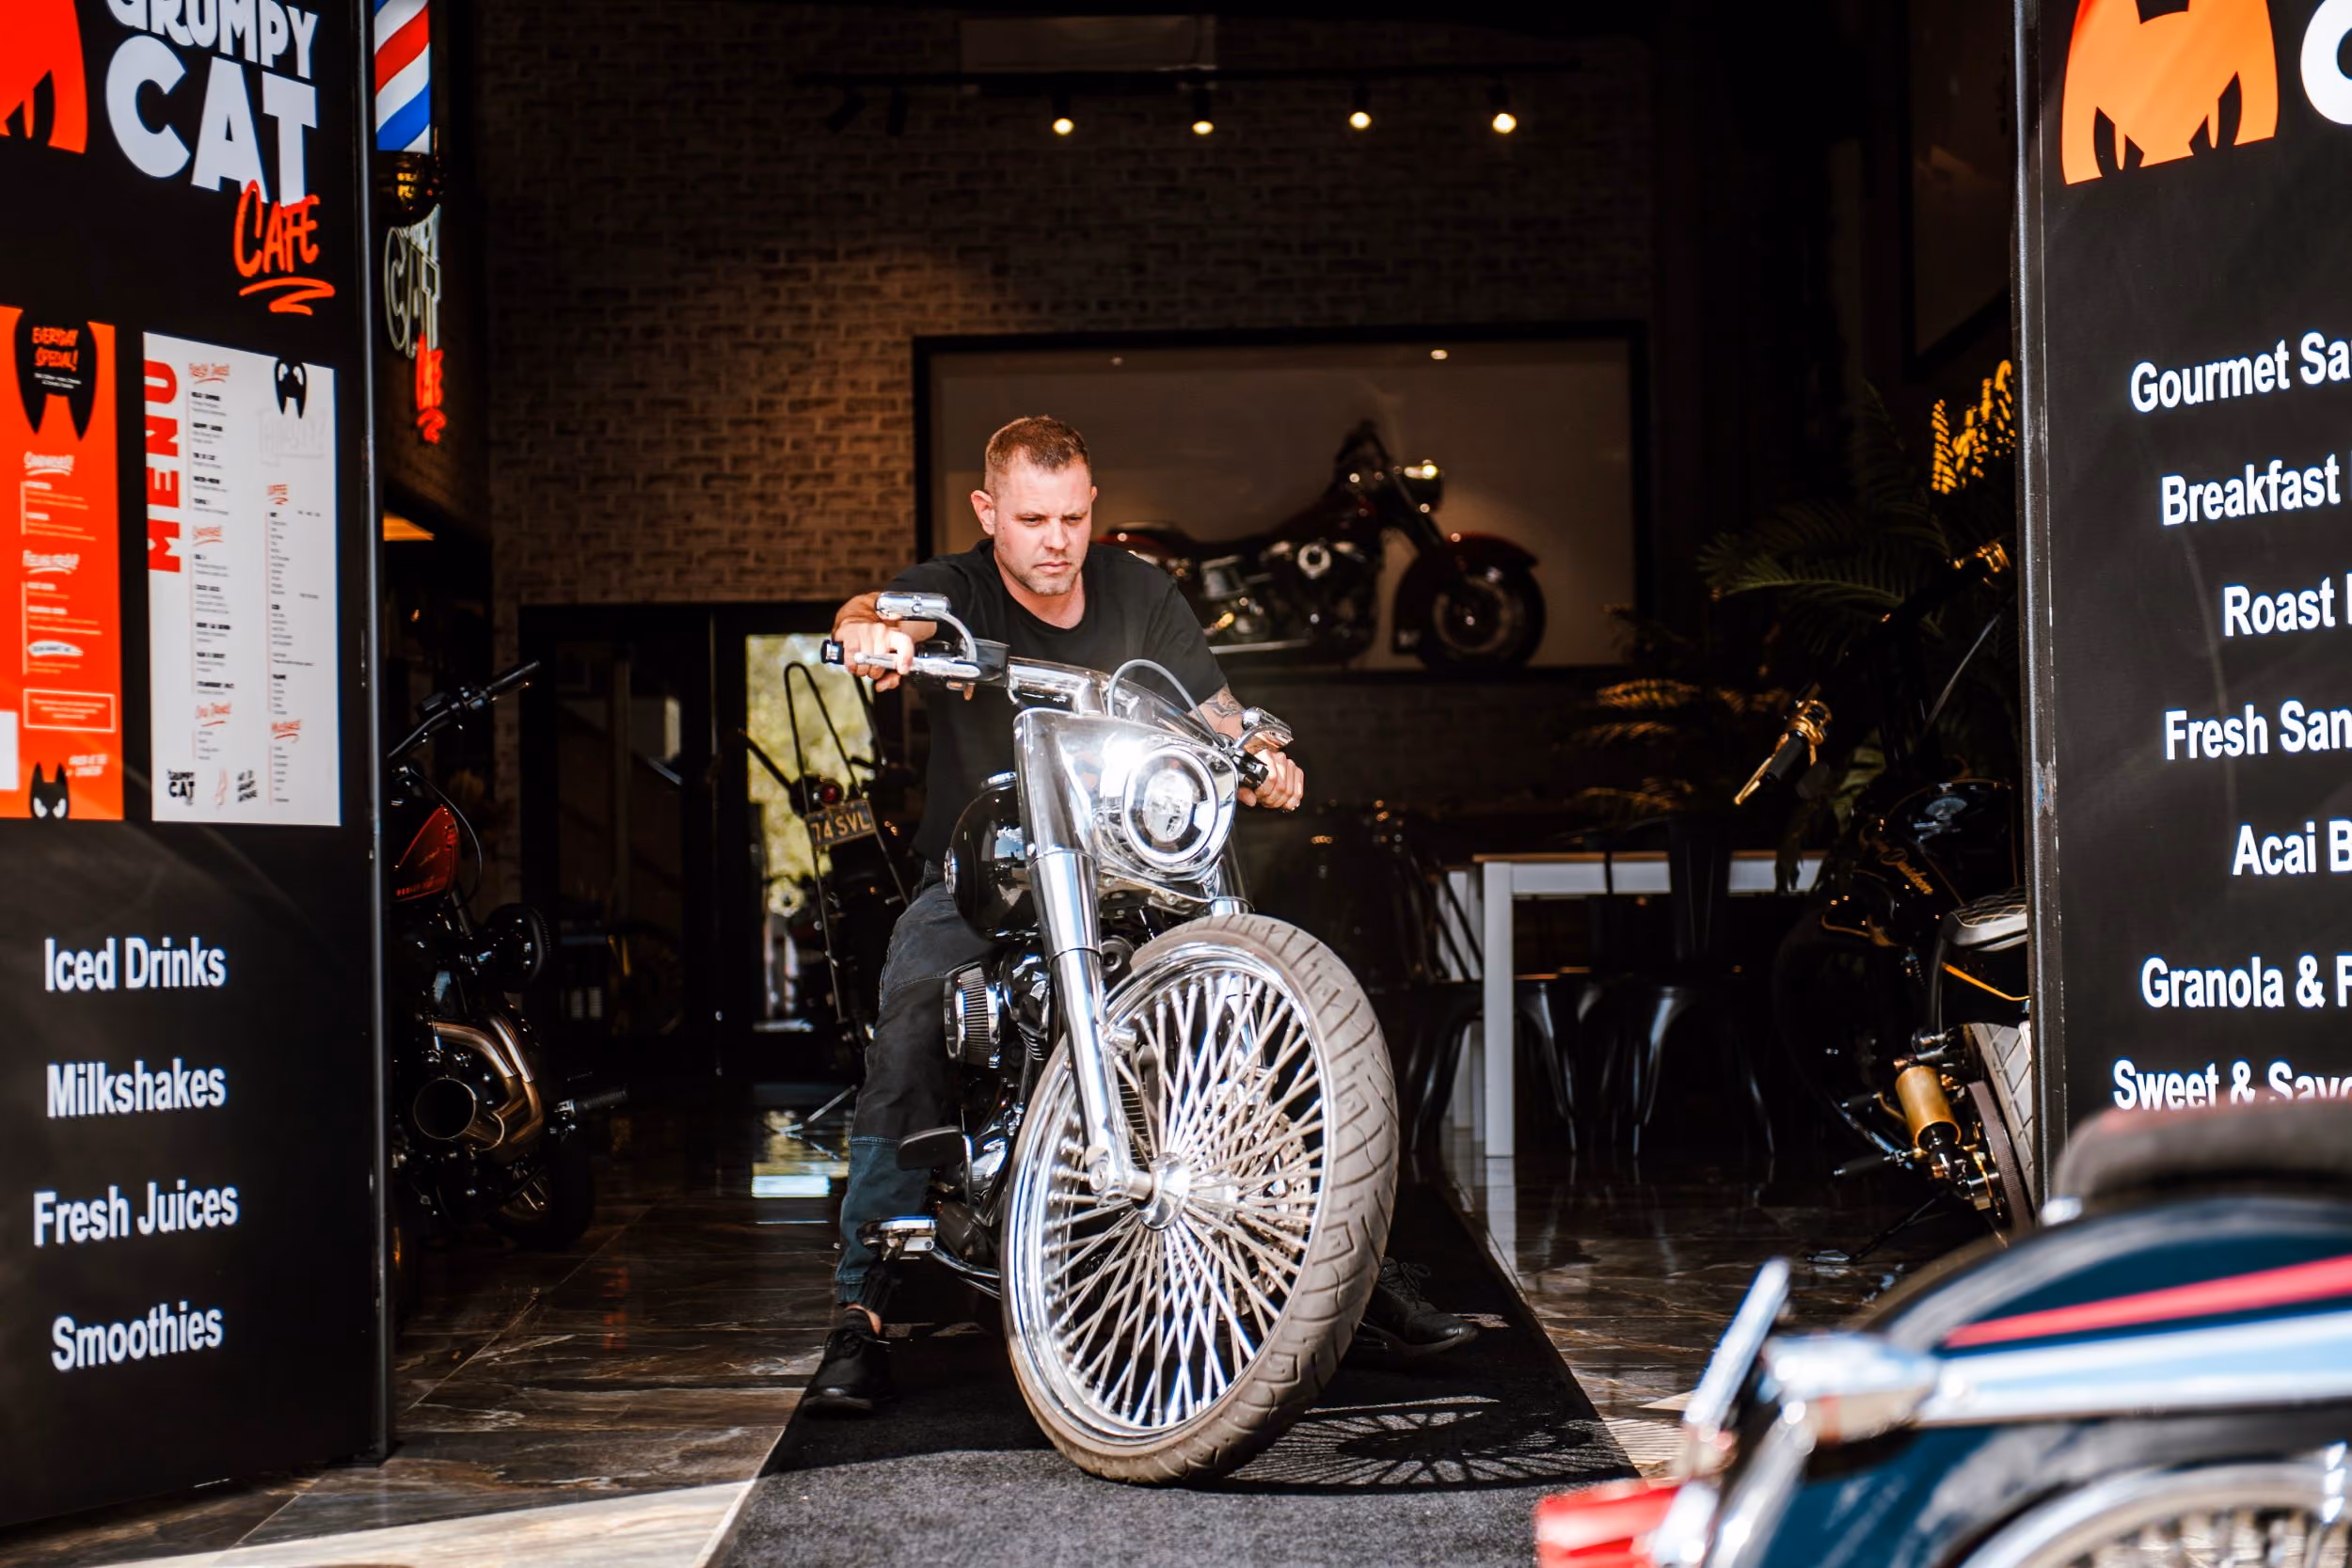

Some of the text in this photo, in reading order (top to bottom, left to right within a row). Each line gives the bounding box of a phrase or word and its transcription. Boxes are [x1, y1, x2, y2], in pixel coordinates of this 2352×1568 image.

[106, 35, 318, 205] CAT
[234, 181, 320, 276] CAFE
[2130, 340, 2291, 413] Gourmet
[144, 358, 182, 573] MENU
[2161, 453, 2342, 527] Breakfast
[2224, 577, 2336, 637] Roast
[2165, 704, 2269, 761] Fresh
[2232, 821, 2317, 876] Acai
[44, 937, 226, 991] Iced Drinks
[2141, 956, 2285, 1008] Granola
[2296, 955, 2327, 1008] &
[47, 1058, 226, 1118] Milkshakes
[2111, 1059, 2219, 1112] Sweet
[33, 1179, 238, 1247] Fresh Juices
[51, 1301, 223, 1371] Smoothies
